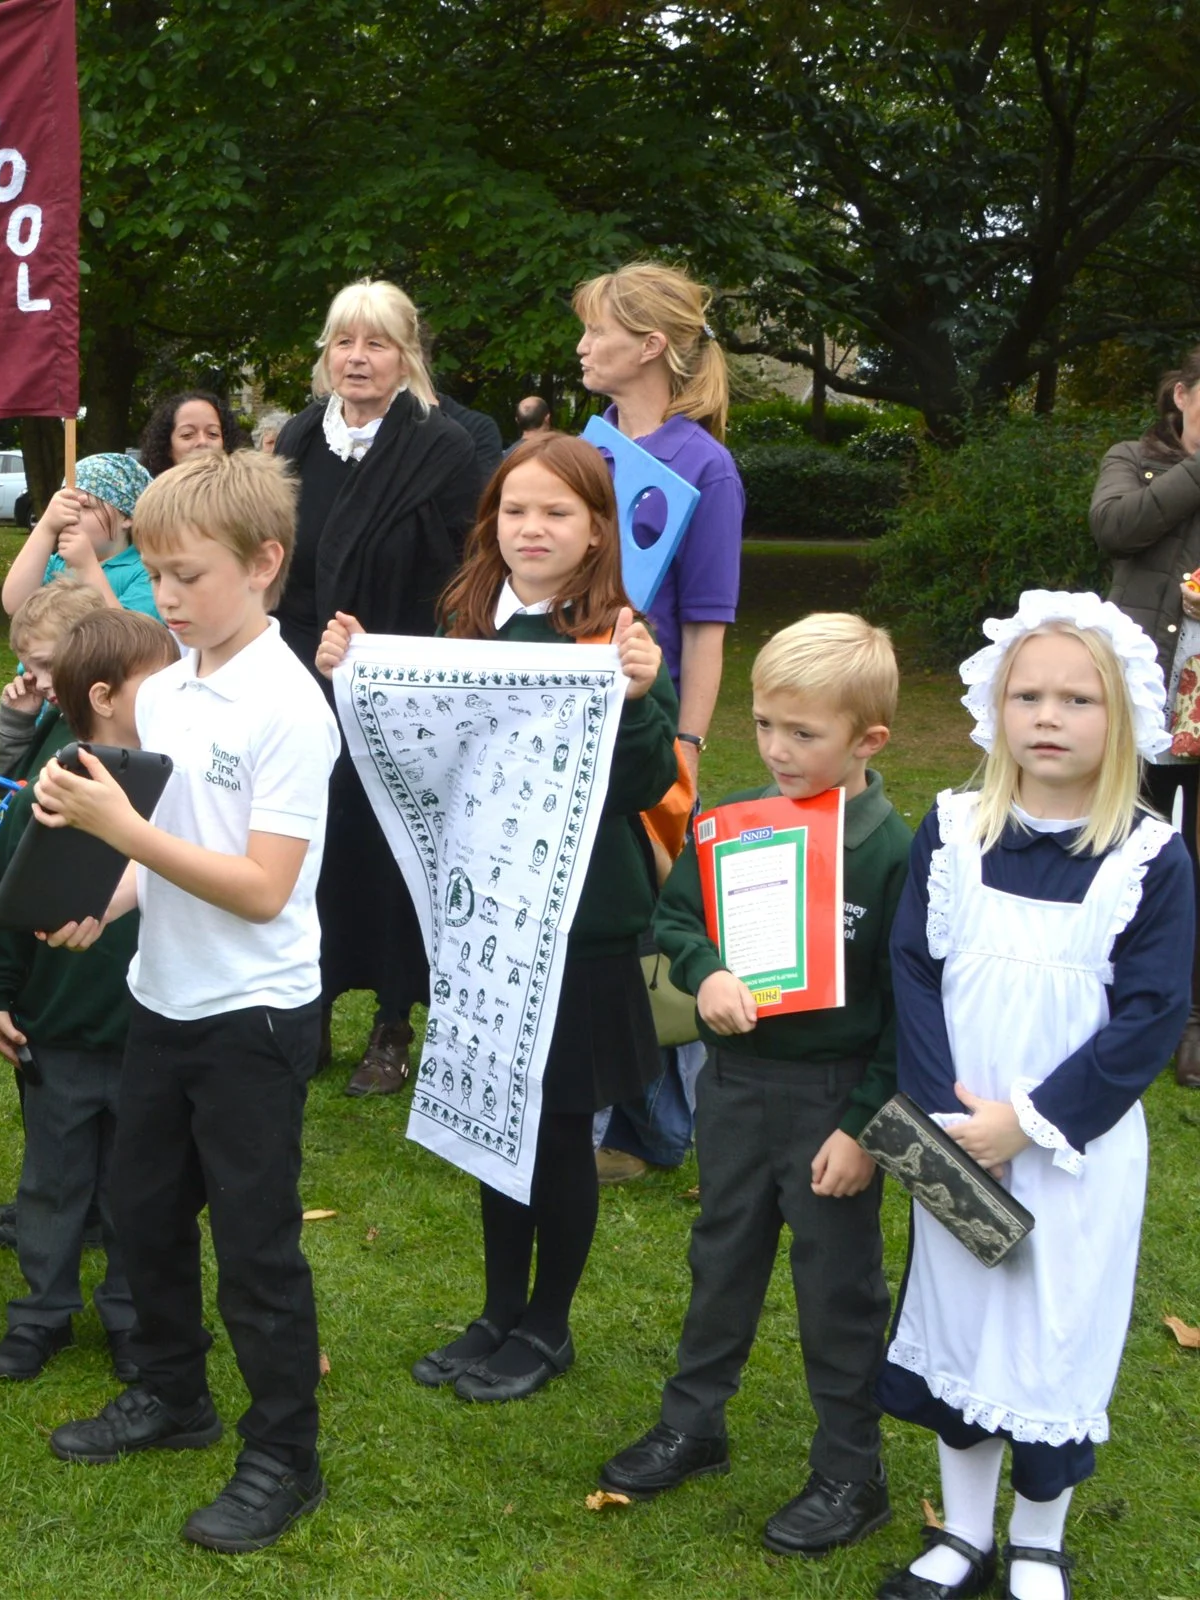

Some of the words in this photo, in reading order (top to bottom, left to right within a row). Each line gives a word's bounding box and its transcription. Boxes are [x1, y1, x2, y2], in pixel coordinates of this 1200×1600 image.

[212, 759, 234, 777] First
[205, 771, 241, 791] School
[743, 829, 770, 842] GINN
